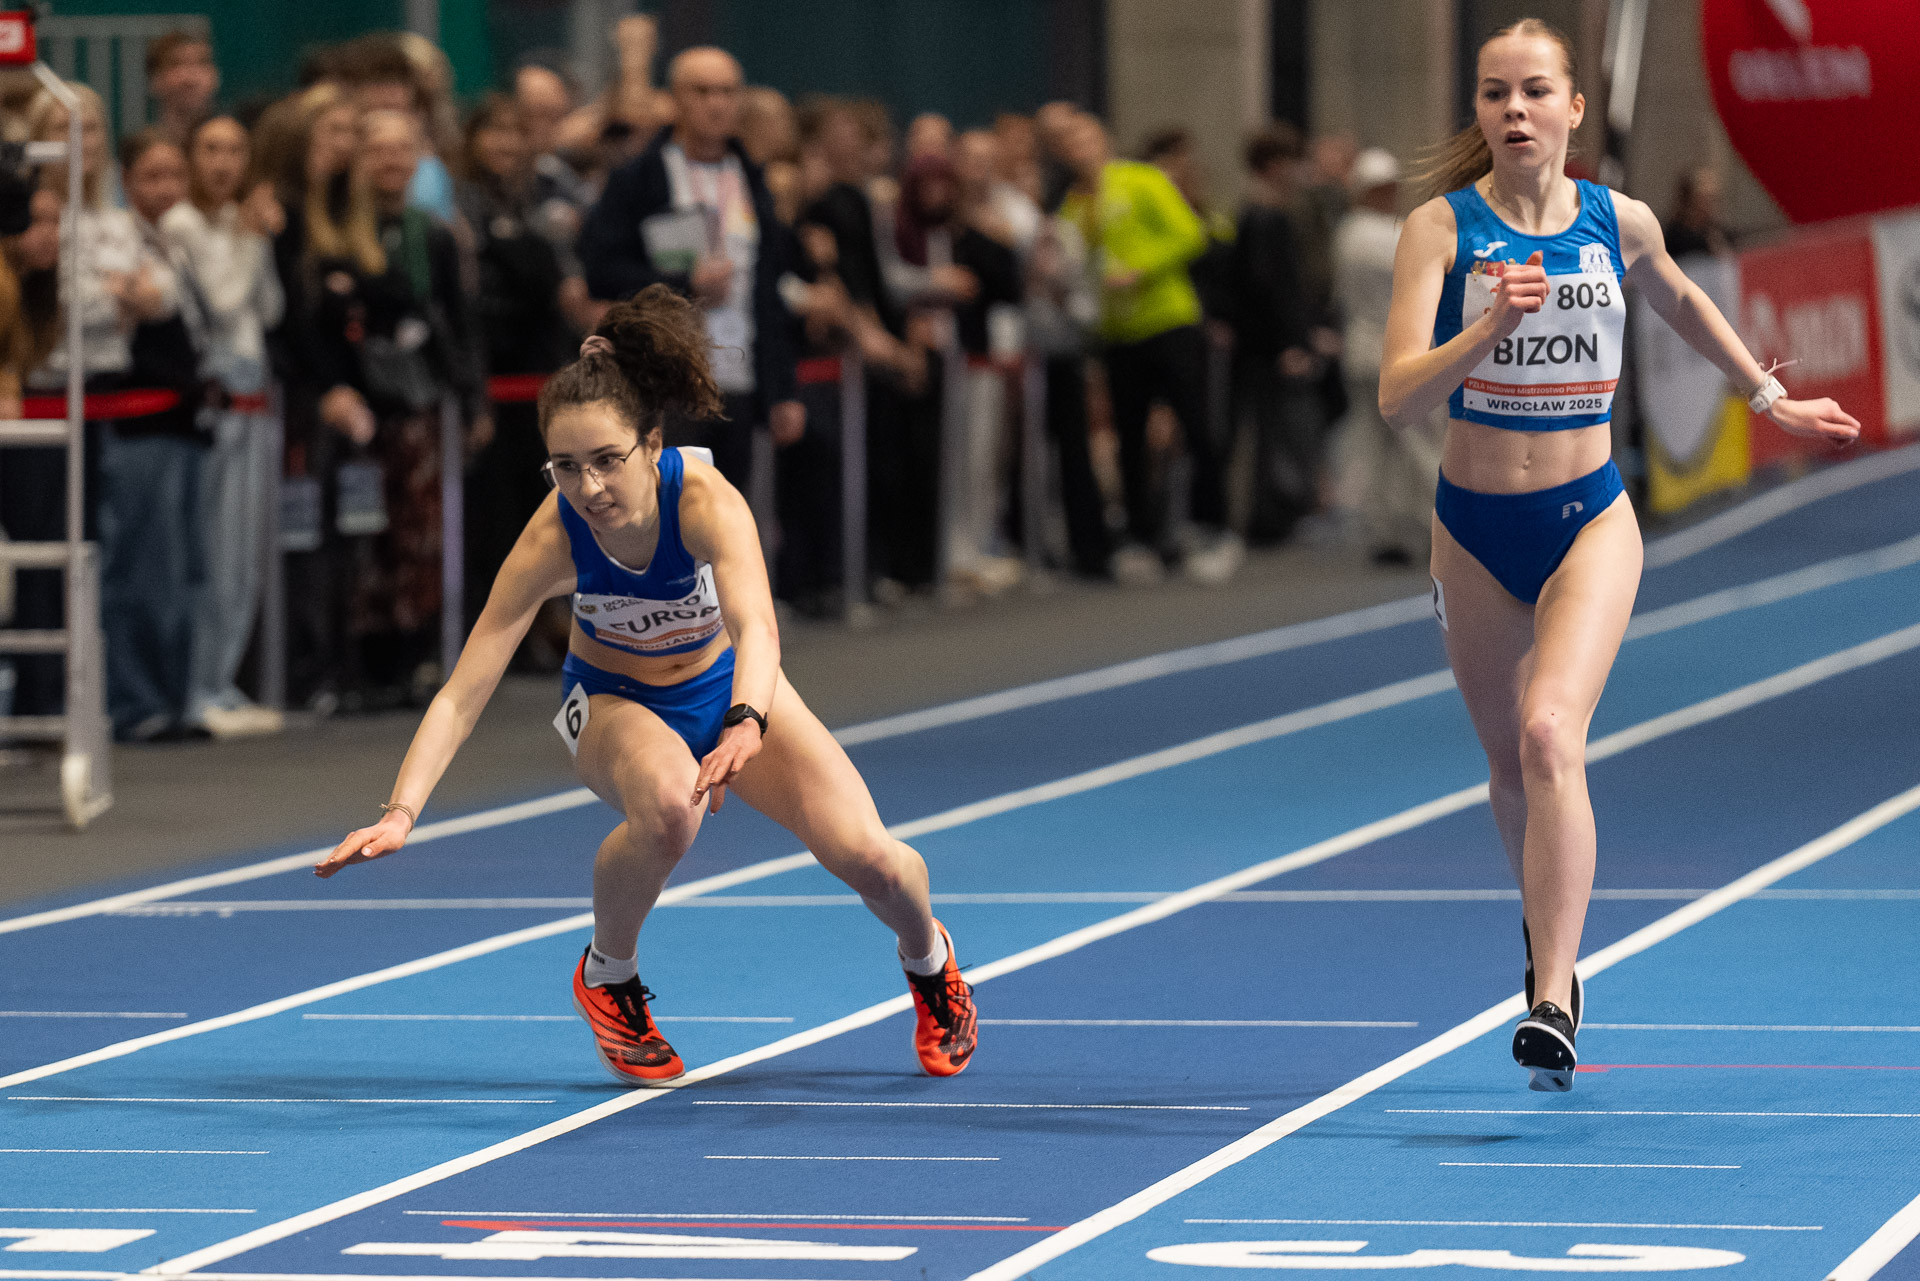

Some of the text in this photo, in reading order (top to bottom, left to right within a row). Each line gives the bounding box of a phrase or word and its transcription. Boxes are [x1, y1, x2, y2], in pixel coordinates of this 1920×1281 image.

[1557, 282, 1611, 310] 803
[1493, 333, 1598, 366] BIZON
[1487, 384, 1515, 394] Halowe
[1566, 384, 1588, 393] Polski
[1486, 398, 1603, 411] WROCŁAW 2025
[566, 698, 582, 740] 6
[1146, 1240, 1746, 1272] 3
